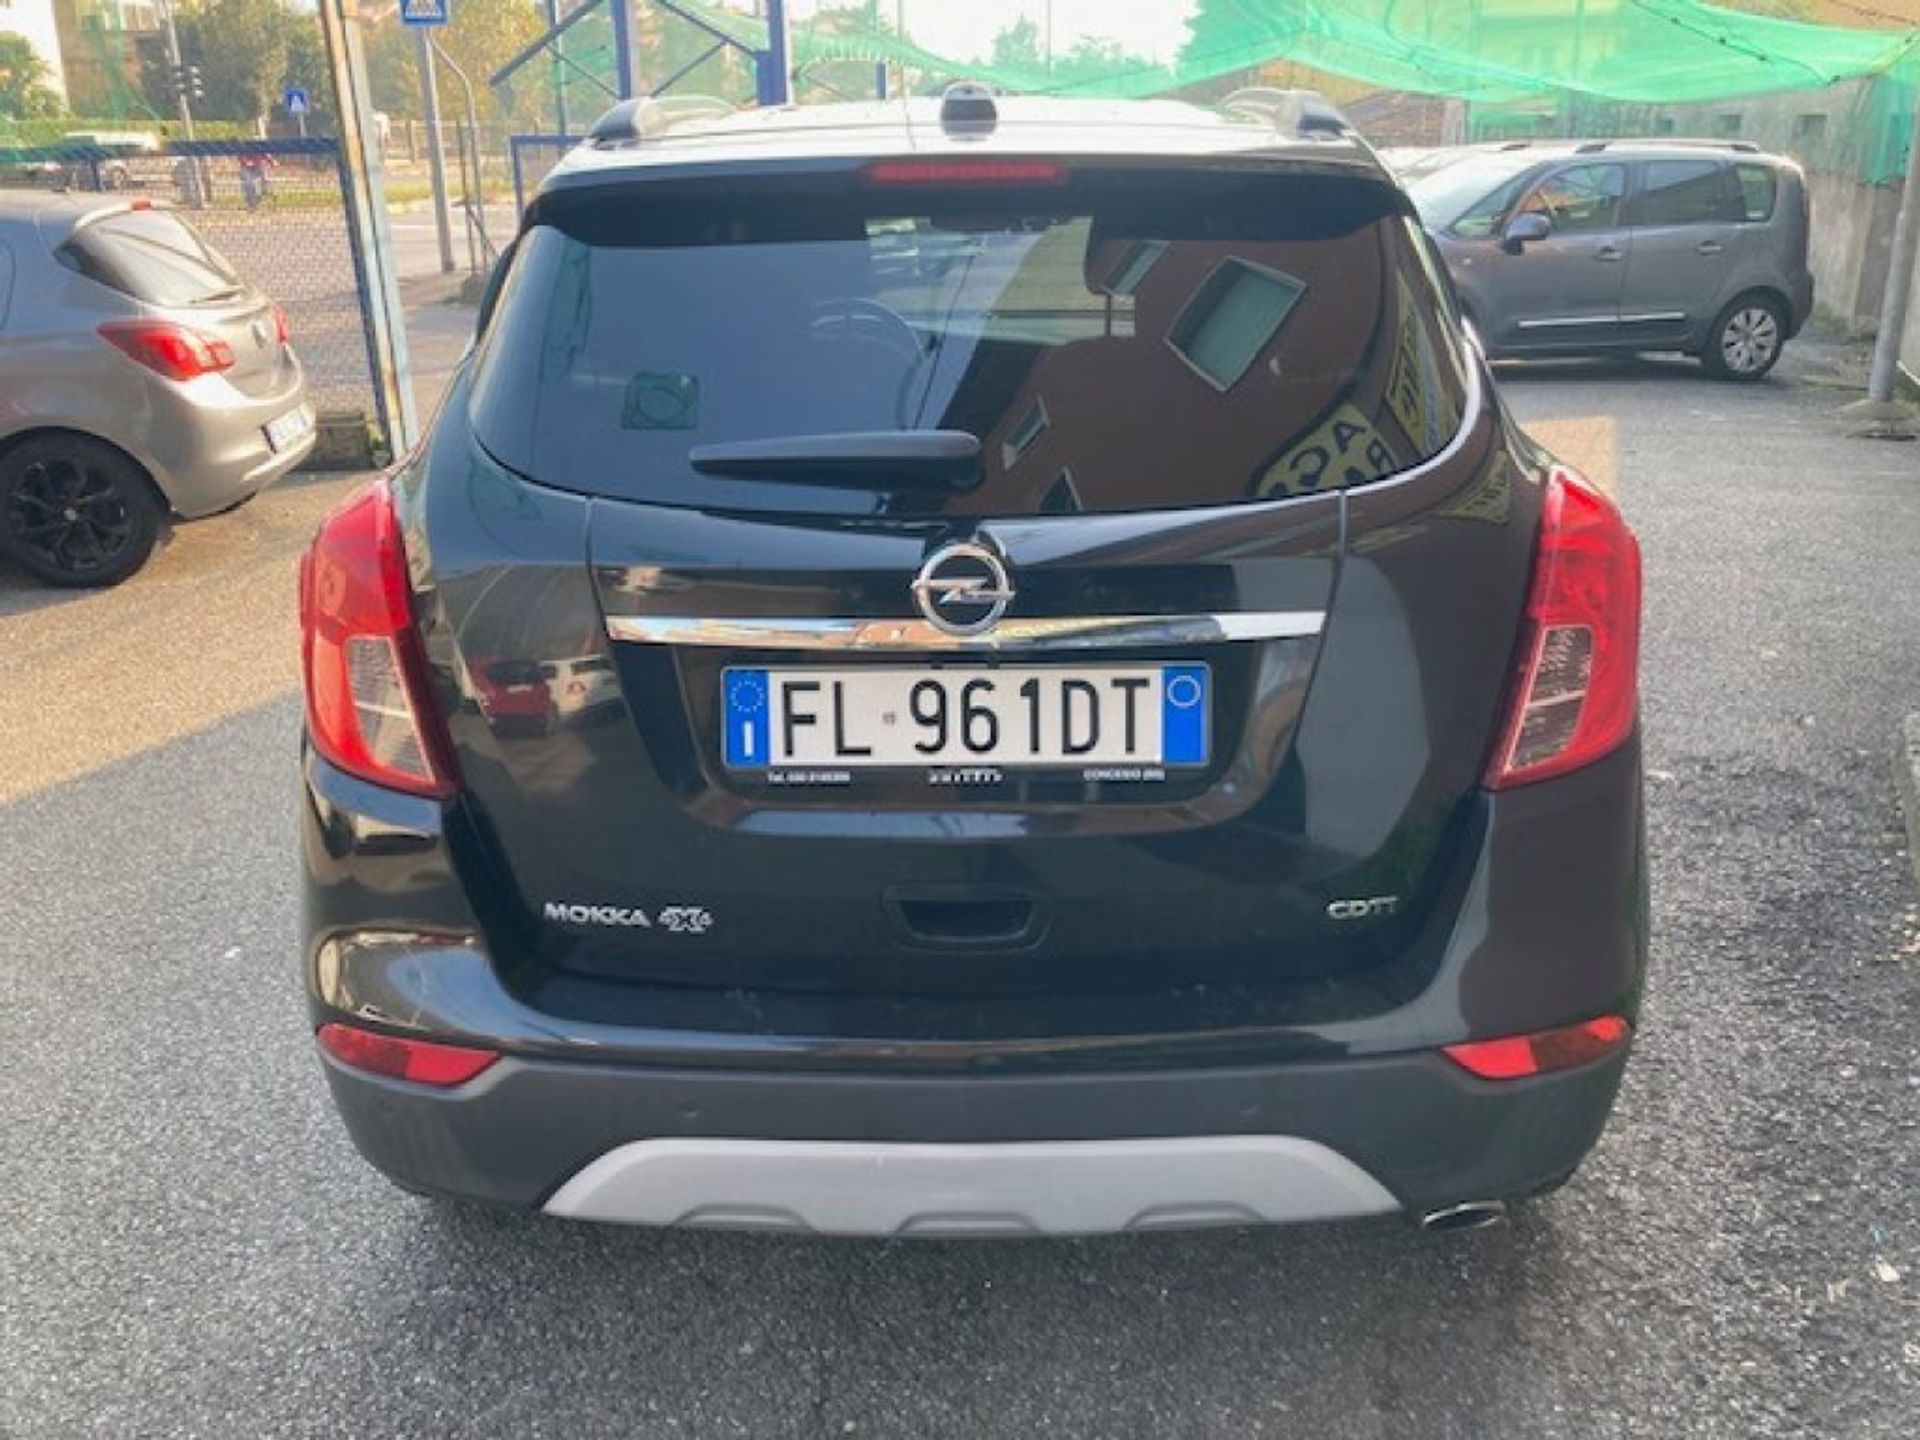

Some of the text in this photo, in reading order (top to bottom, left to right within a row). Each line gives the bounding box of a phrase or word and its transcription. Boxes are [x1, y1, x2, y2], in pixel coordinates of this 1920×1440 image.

[781, 680, 872, 757] FL
[909, 677, 1150, 756] 961DT
[544, 902, 651, 928] MOKKA
